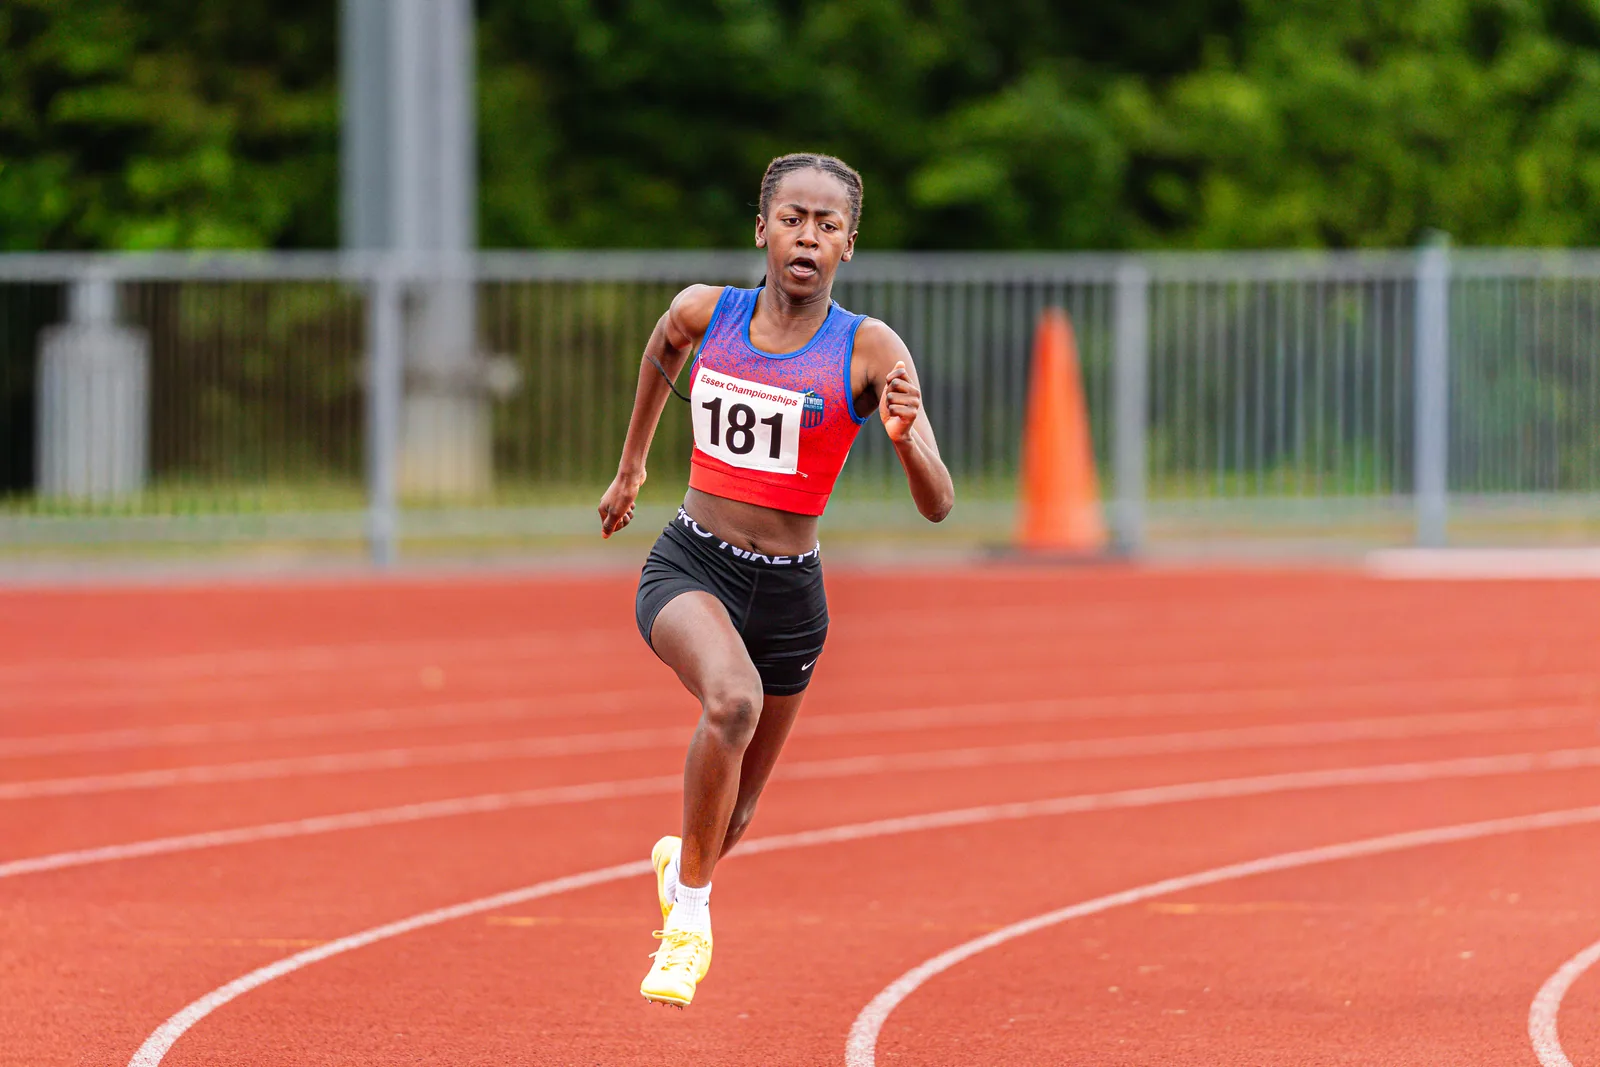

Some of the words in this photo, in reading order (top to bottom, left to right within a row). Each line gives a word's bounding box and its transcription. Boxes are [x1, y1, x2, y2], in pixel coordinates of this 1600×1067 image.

[700, 374, 725, 389] Essex
[726, 382, 798, 407] Championships
[702, 396, 784, 460] 181
